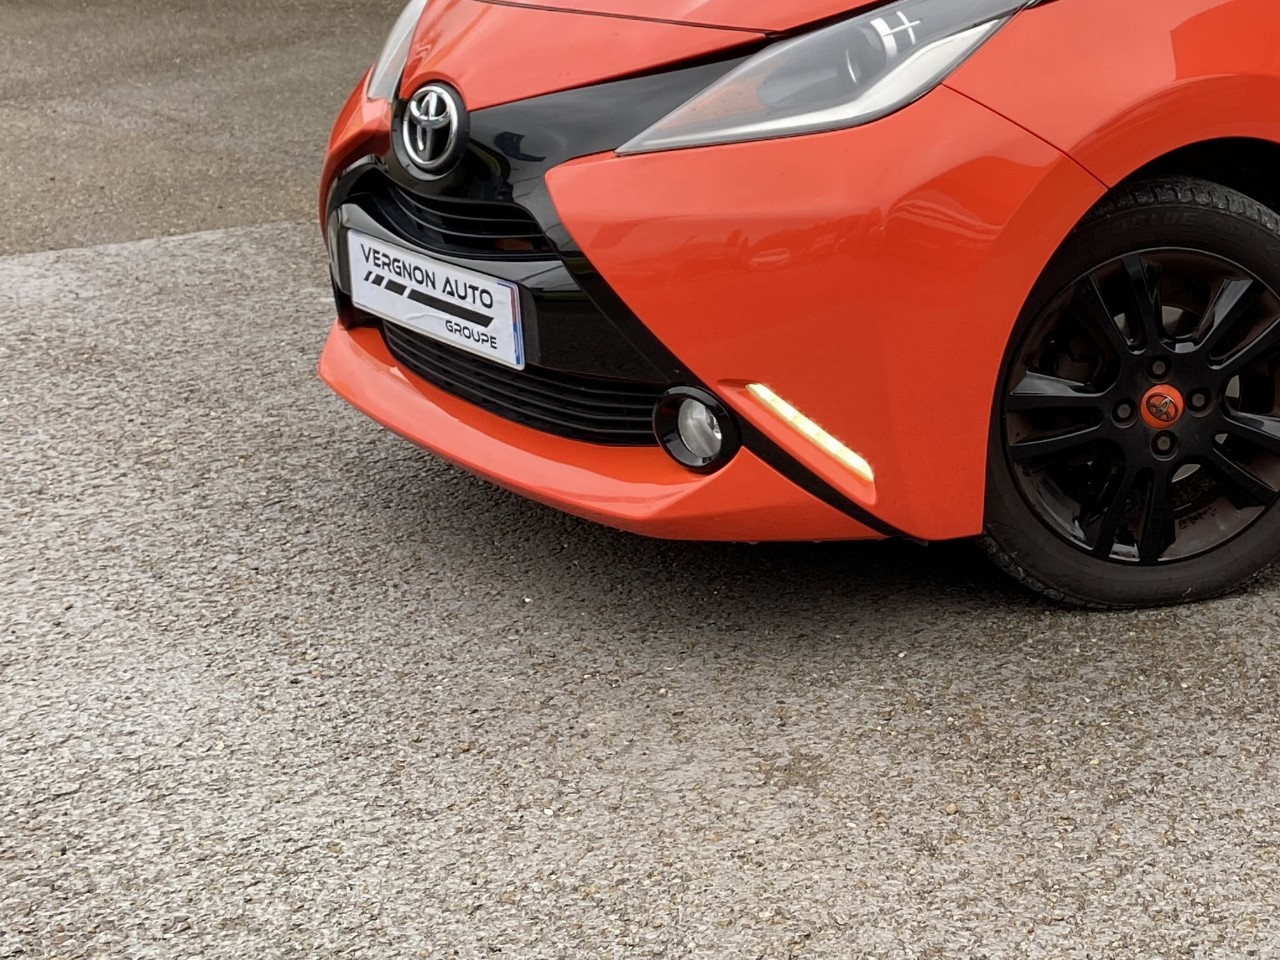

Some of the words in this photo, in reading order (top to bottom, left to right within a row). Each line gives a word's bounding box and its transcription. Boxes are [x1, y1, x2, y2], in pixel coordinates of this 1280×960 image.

[360, 243, 437, 290] VERGNON
[441, 276, 494, 309] AUTO
[445, 319, 498, 350] GROUPE
